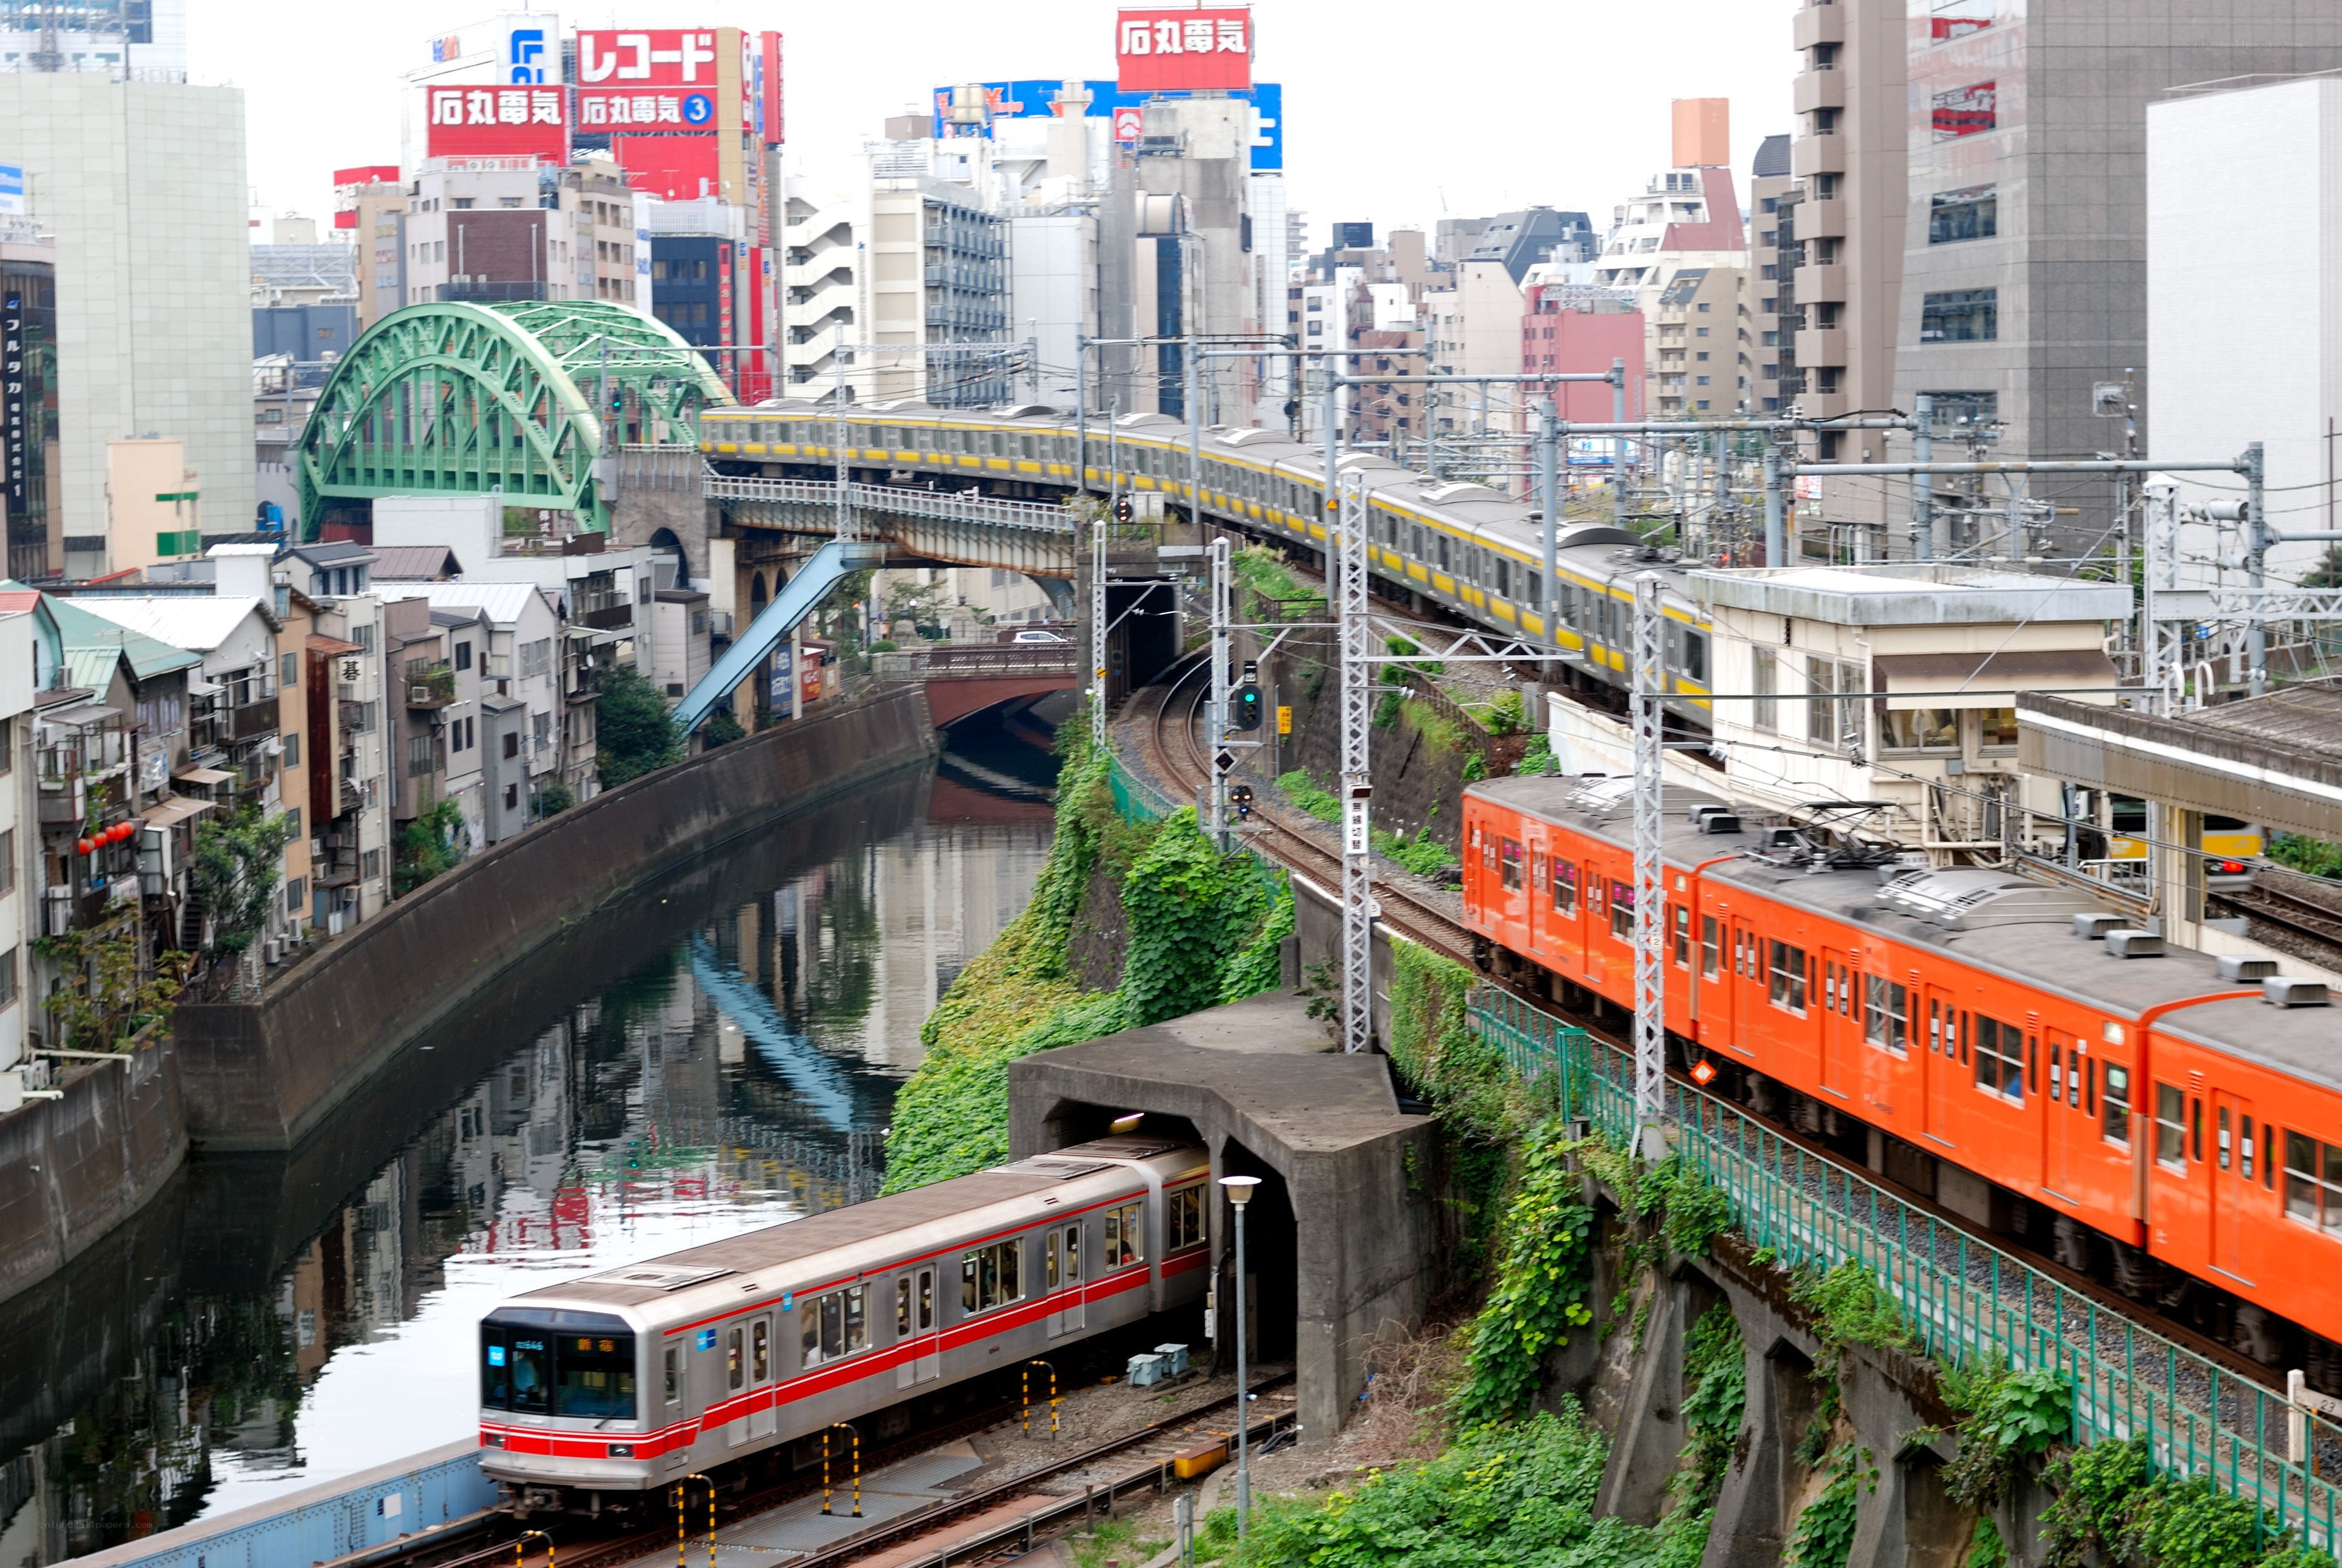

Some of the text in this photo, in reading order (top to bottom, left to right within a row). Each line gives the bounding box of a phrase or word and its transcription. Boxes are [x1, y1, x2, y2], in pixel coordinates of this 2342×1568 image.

[1121, 19, 1247, 56] 石丸電気
[580, 33, 715, 82] レコード
[431, 90, 562, 125] 石丸電気
[581, 95, 707, 125] 石丸電気 3
[342, 661, 361, 680] 碁
[2321, 1399, 2336, 1413] 23
